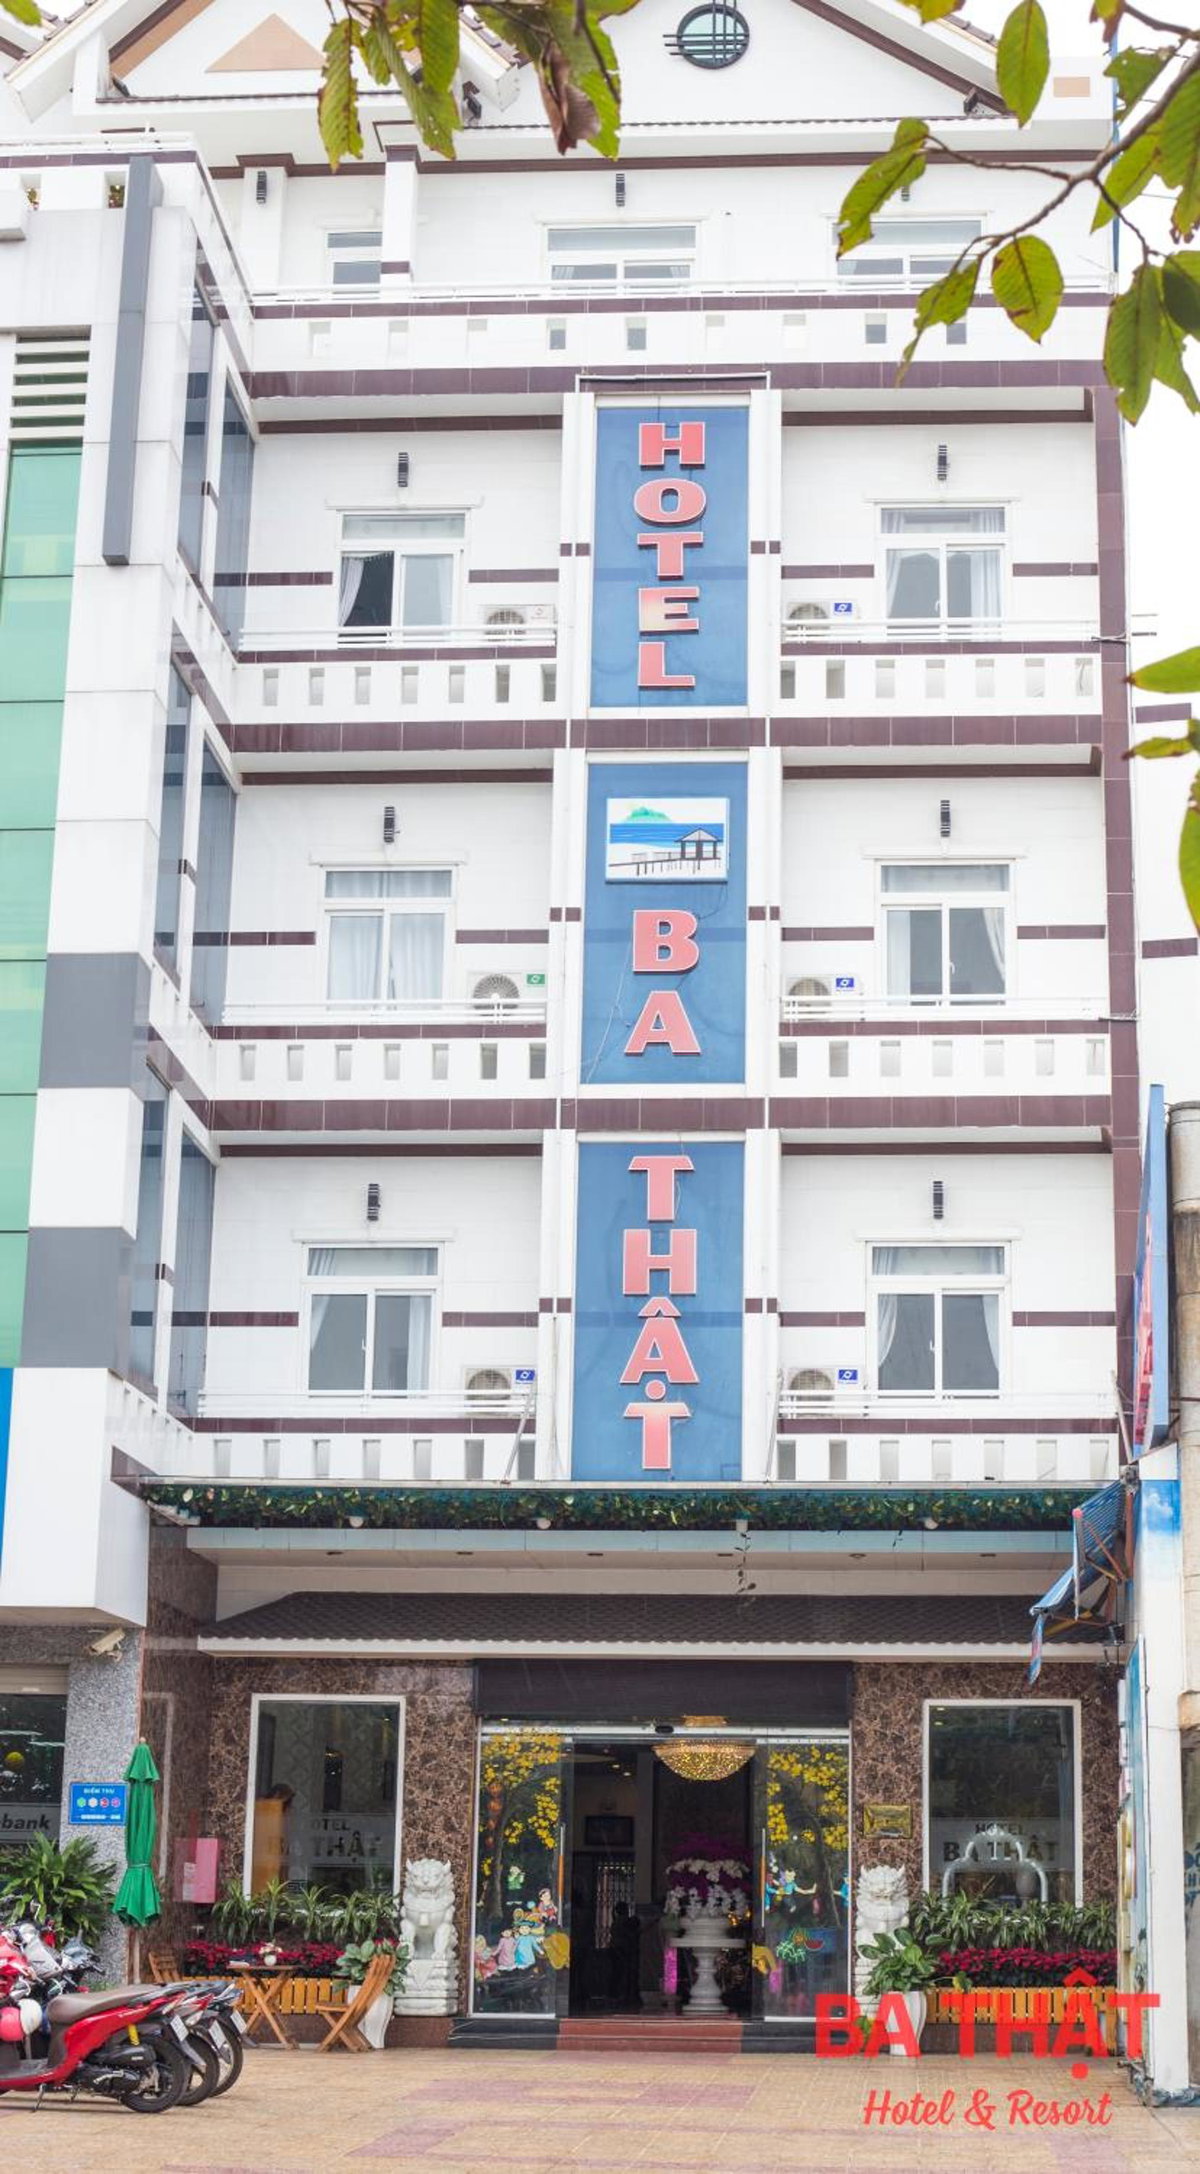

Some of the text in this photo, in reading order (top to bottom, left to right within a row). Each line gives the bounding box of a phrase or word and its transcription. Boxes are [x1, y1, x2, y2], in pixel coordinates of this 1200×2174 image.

[633, 421, 706, 688] HOTEL
[624, 909, 701, 1055] BA
[620, 1155, 699, 1470] THẬT
[305, 1818, 351, 1831] OTEL
